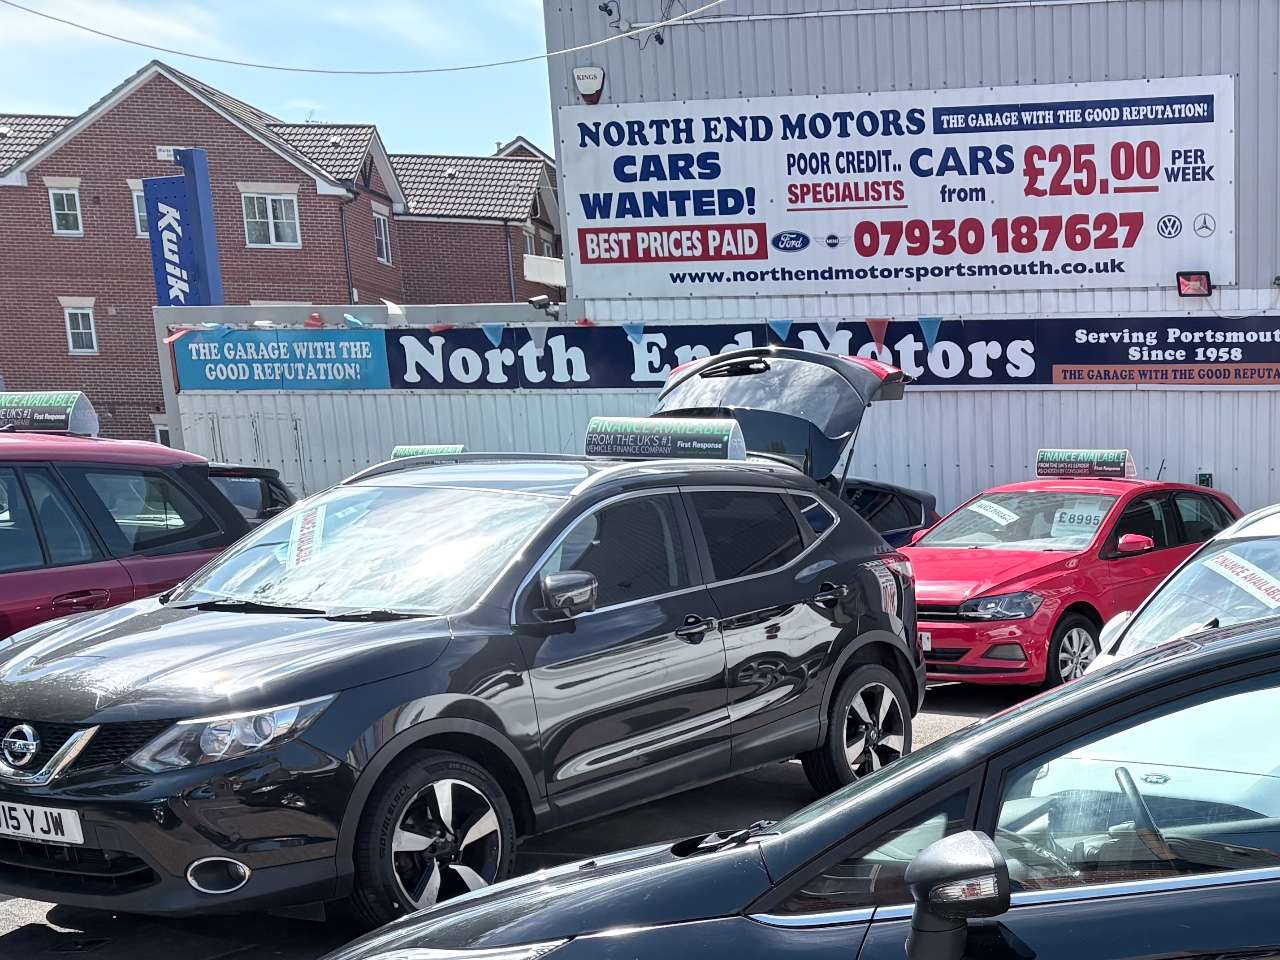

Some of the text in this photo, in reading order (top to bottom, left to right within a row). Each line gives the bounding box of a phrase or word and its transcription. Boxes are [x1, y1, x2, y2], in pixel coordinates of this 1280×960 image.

[941, 102, 1208, 129] THE GARAGE WITH THE GOOD REPUTATION!
[577, 108, 926, 147] NORTH END MOTORS
[787, 151, 832, 175] POOR
[1171, 149, 1206, 166] PER
[613, 152, 721, 182] CARS
[909, 140, 1160, 198] CARS £25.00
[1164, 165, 1215, 182] WEEK
[787, 179, 905, 204] SPECIALISTS
[940, 184, 986, 202] from
[580, 187, 756, 220] WANTED!
[586, 228, 759, 259] BEST PRICES PAID
[776, 232, 806, 249] Ford
[854, 212, 1144, 258] 07930 187627
[158, 202, 190, 305] Kwik
[669, 259, 1125, 283] www.northendmotorsportsmouth.co.uk
[1075, 328, 1158, 345] Serving
[188, 341, 371, 359] THE GARAGE WITH THE
[399, 334, 591, 384] North
[1128, 346, 1242, 361] Since 1958
[205, 362, 360, 380] GOOD REPUTATION!
[1062, 369, 1083, 380] THE
[1087, 369, 1135, 380] GARAGE
[1138, 369, 1169, 380] WITH
[1172, 368, 1194, 379] THE
[1197, 368, 1231, 379] GOOD
[21, 394, 78, 407] AVAILABLE
[588, 419, 731, 436] FINANCE AVAILABLE
[586, 434, 672, 446] FROM THE UK'S #1
[677, 440, 723, 449] First Response
[586, 445, 611, 453] VEHICLE
[612, 445, 640, 453] FINANCE
[641, 446, 672, 454] COMPANY
[1039, 452, 1126, 462] FINANCE AVAILABLE
[1211, 555, 1250, 577] FINANCE
[0, 805, 20, 831] 15
